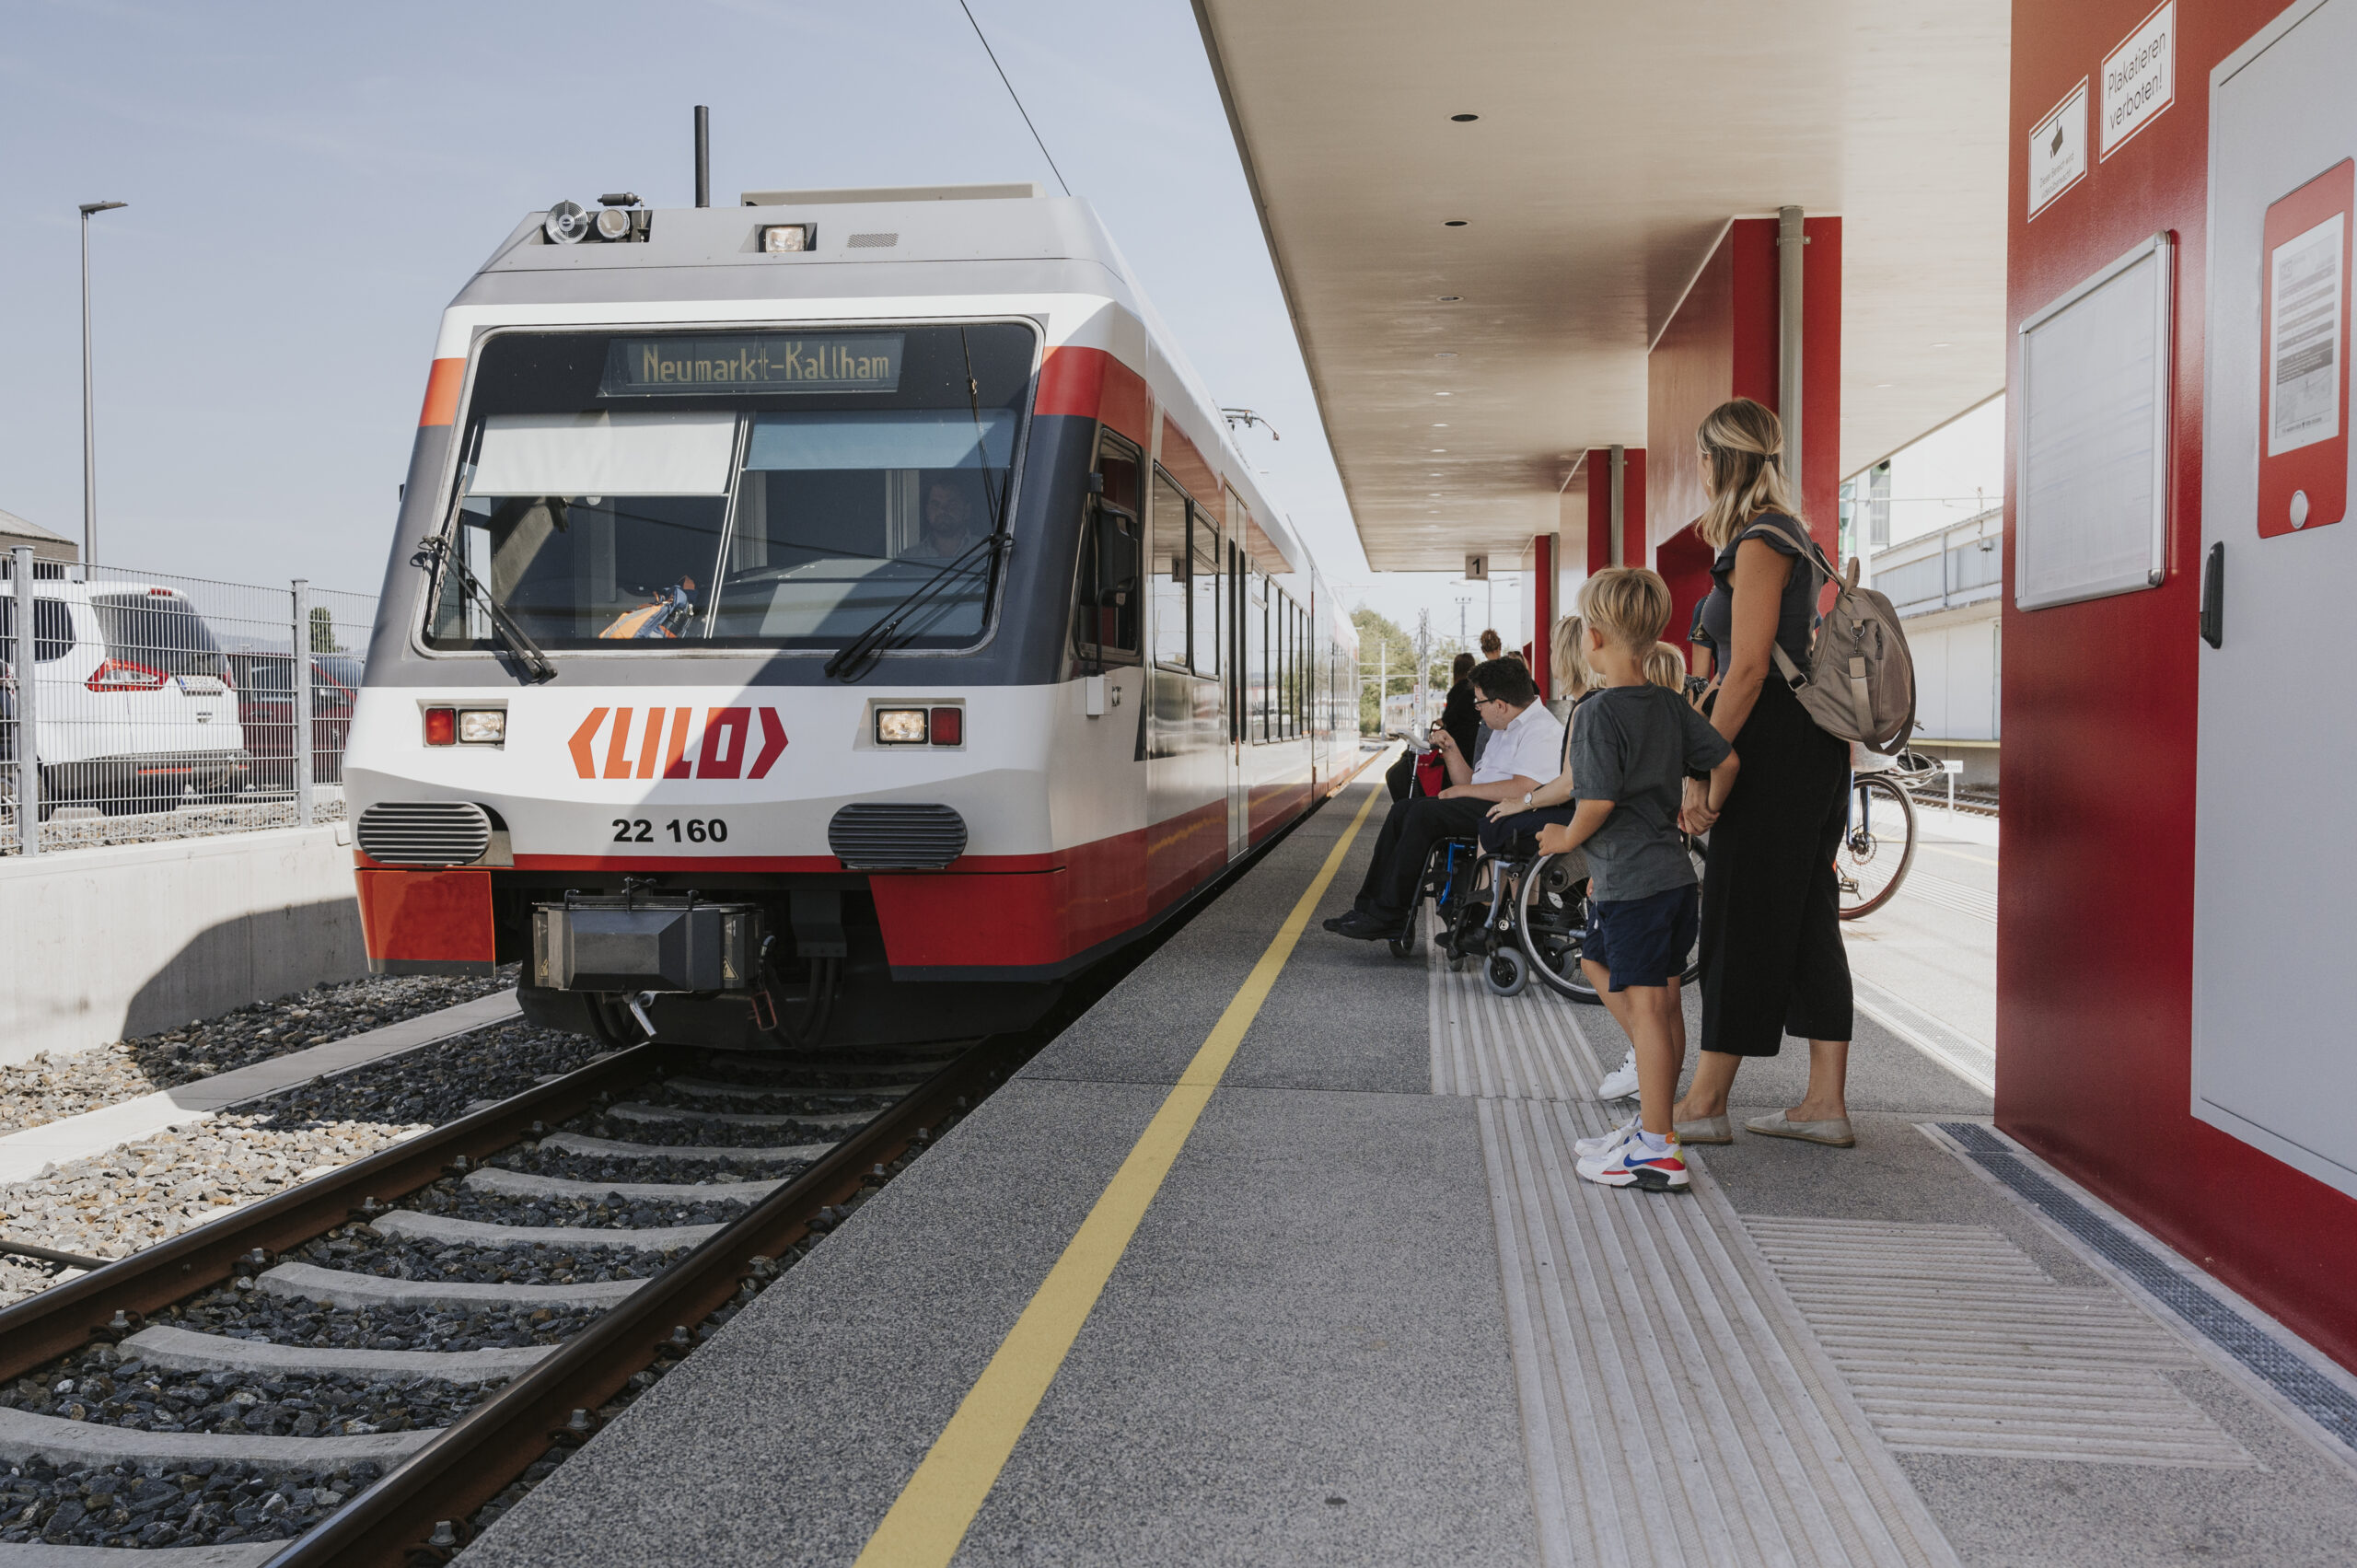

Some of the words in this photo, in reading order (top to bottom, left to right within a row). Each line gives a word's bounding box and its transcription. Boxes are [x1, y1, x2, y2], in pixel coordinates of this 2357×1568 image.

[2107, 32, 2166, 99] Plakatieren
[2109, 63, 2163, 130] verboten!
[643, 341, 889, 383] Neumarkt-Kallham
[1472, 558, 1480, 575] 1
[603, 707, 751, 779] LILO
[612, 819, 654, 842] 22
[666, 819, 728, 842] 160
